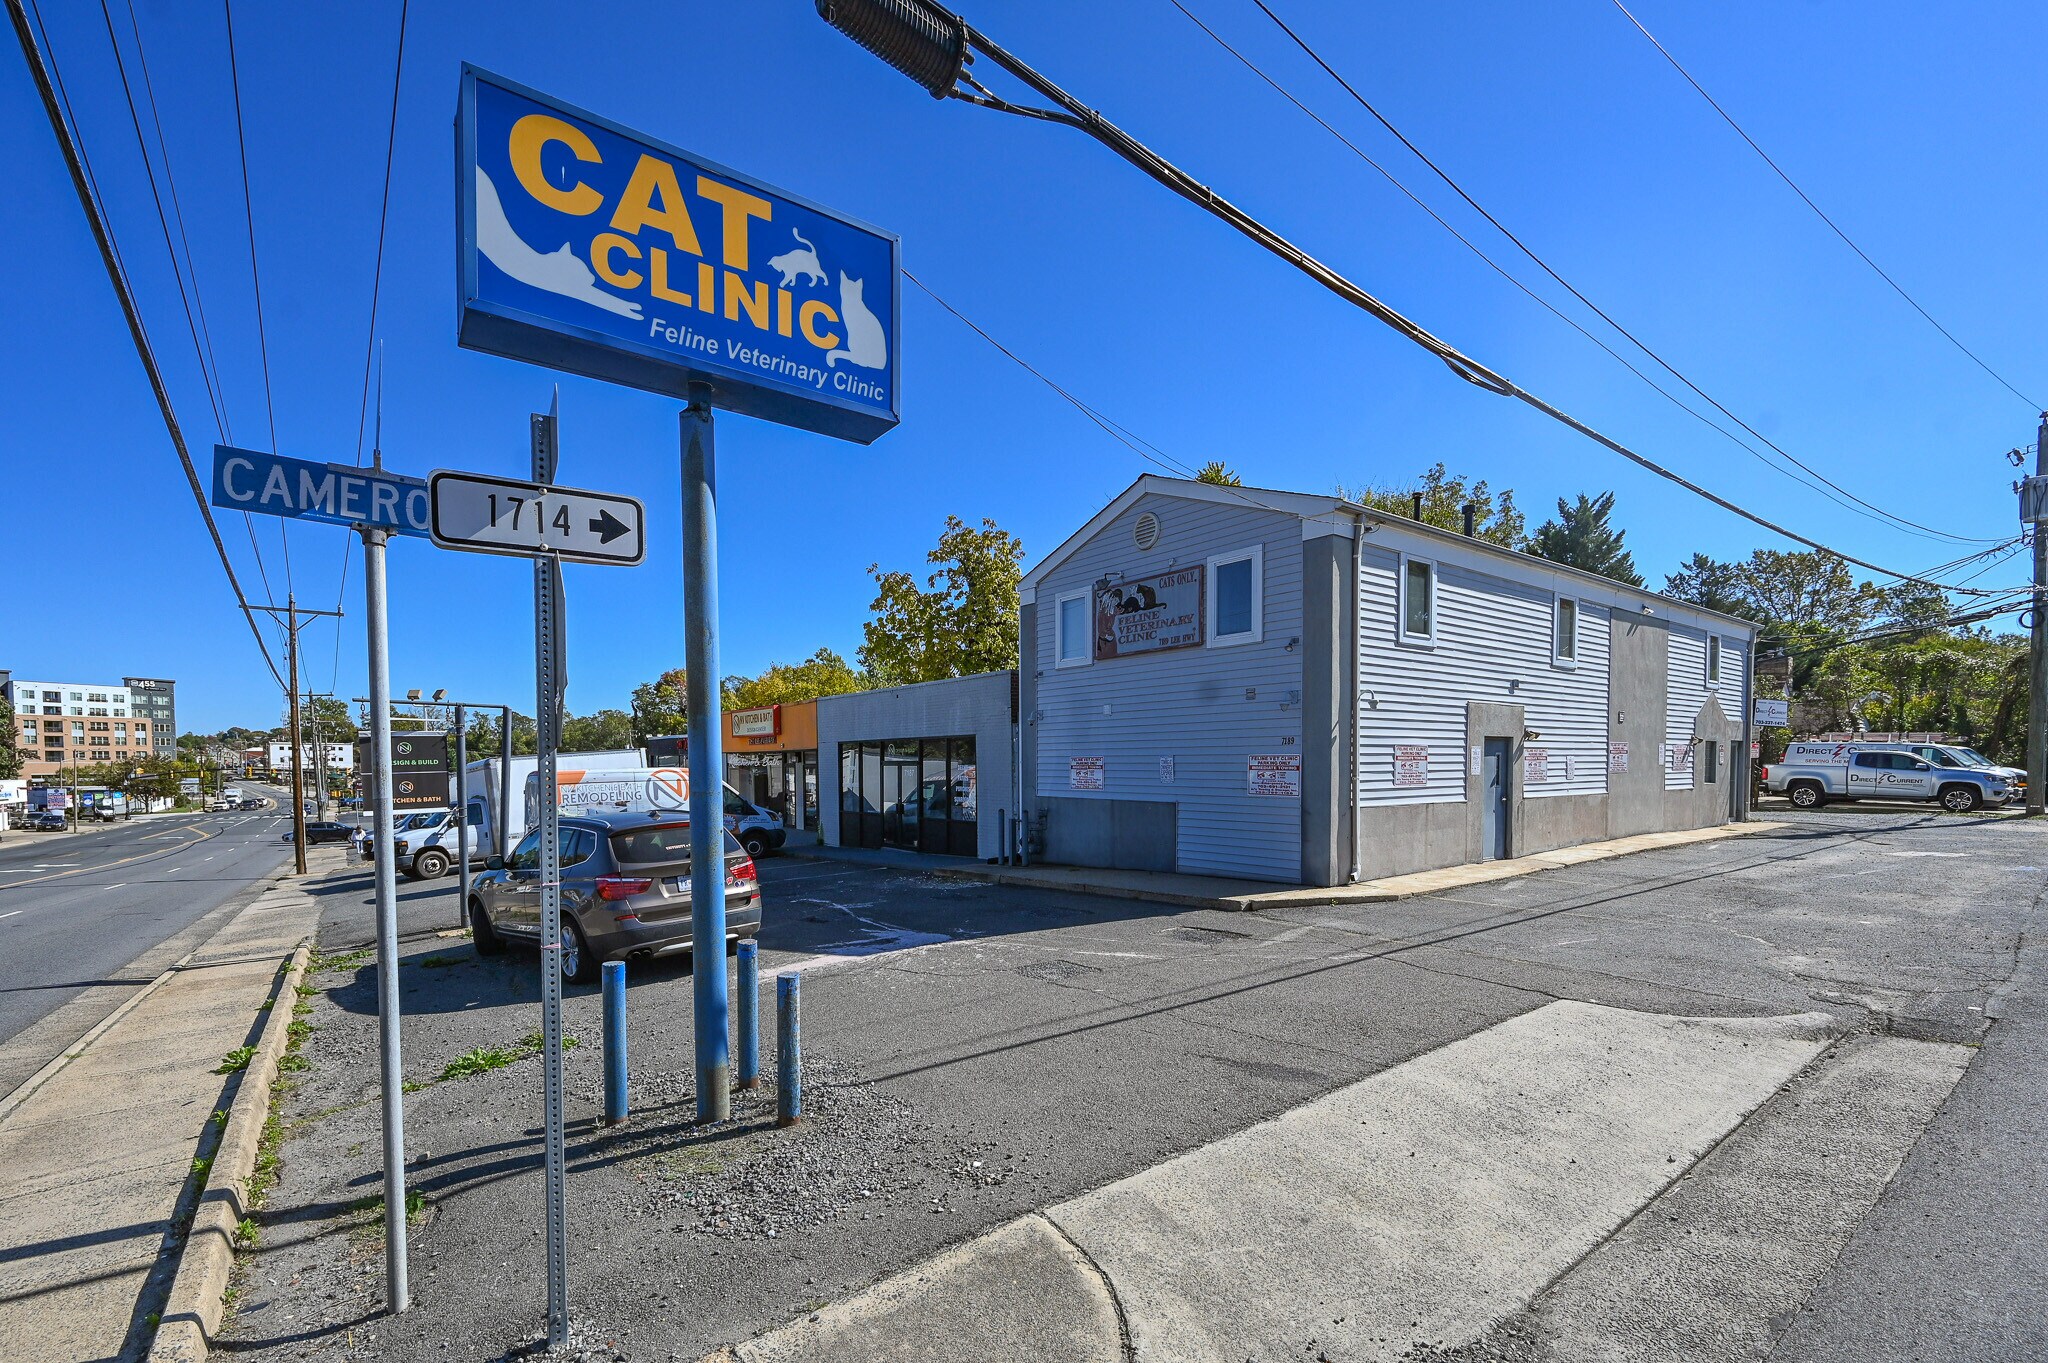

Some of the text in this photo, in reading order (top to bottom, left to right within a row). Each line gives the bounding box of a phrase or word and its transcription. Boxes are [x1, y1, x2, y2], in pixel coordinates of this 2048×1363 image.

[508, 114, 772, 272] CAT
[590, 232, 840, 350] CLINIC
[649, 317, 885, 401] Feline Veterinary Clinic
[488, 493, 571, 536] 1714
[1159, 575, 1175, 588] CATS
[1118, 611, 1160, 626] FELINE
[1118, 613, 1195, 635] VETERINARY
[1118, 630, 1158, 644] CLINIC
[1796, 746, 1833, 755] DIRECT
[1850, 774, 1924, 784] DIRECT CURRENT
[576, 784, 611, 792] KITCHEN
[620, 783, 643, 791] BATH
[562, 791, 642, 805] REMODELING
